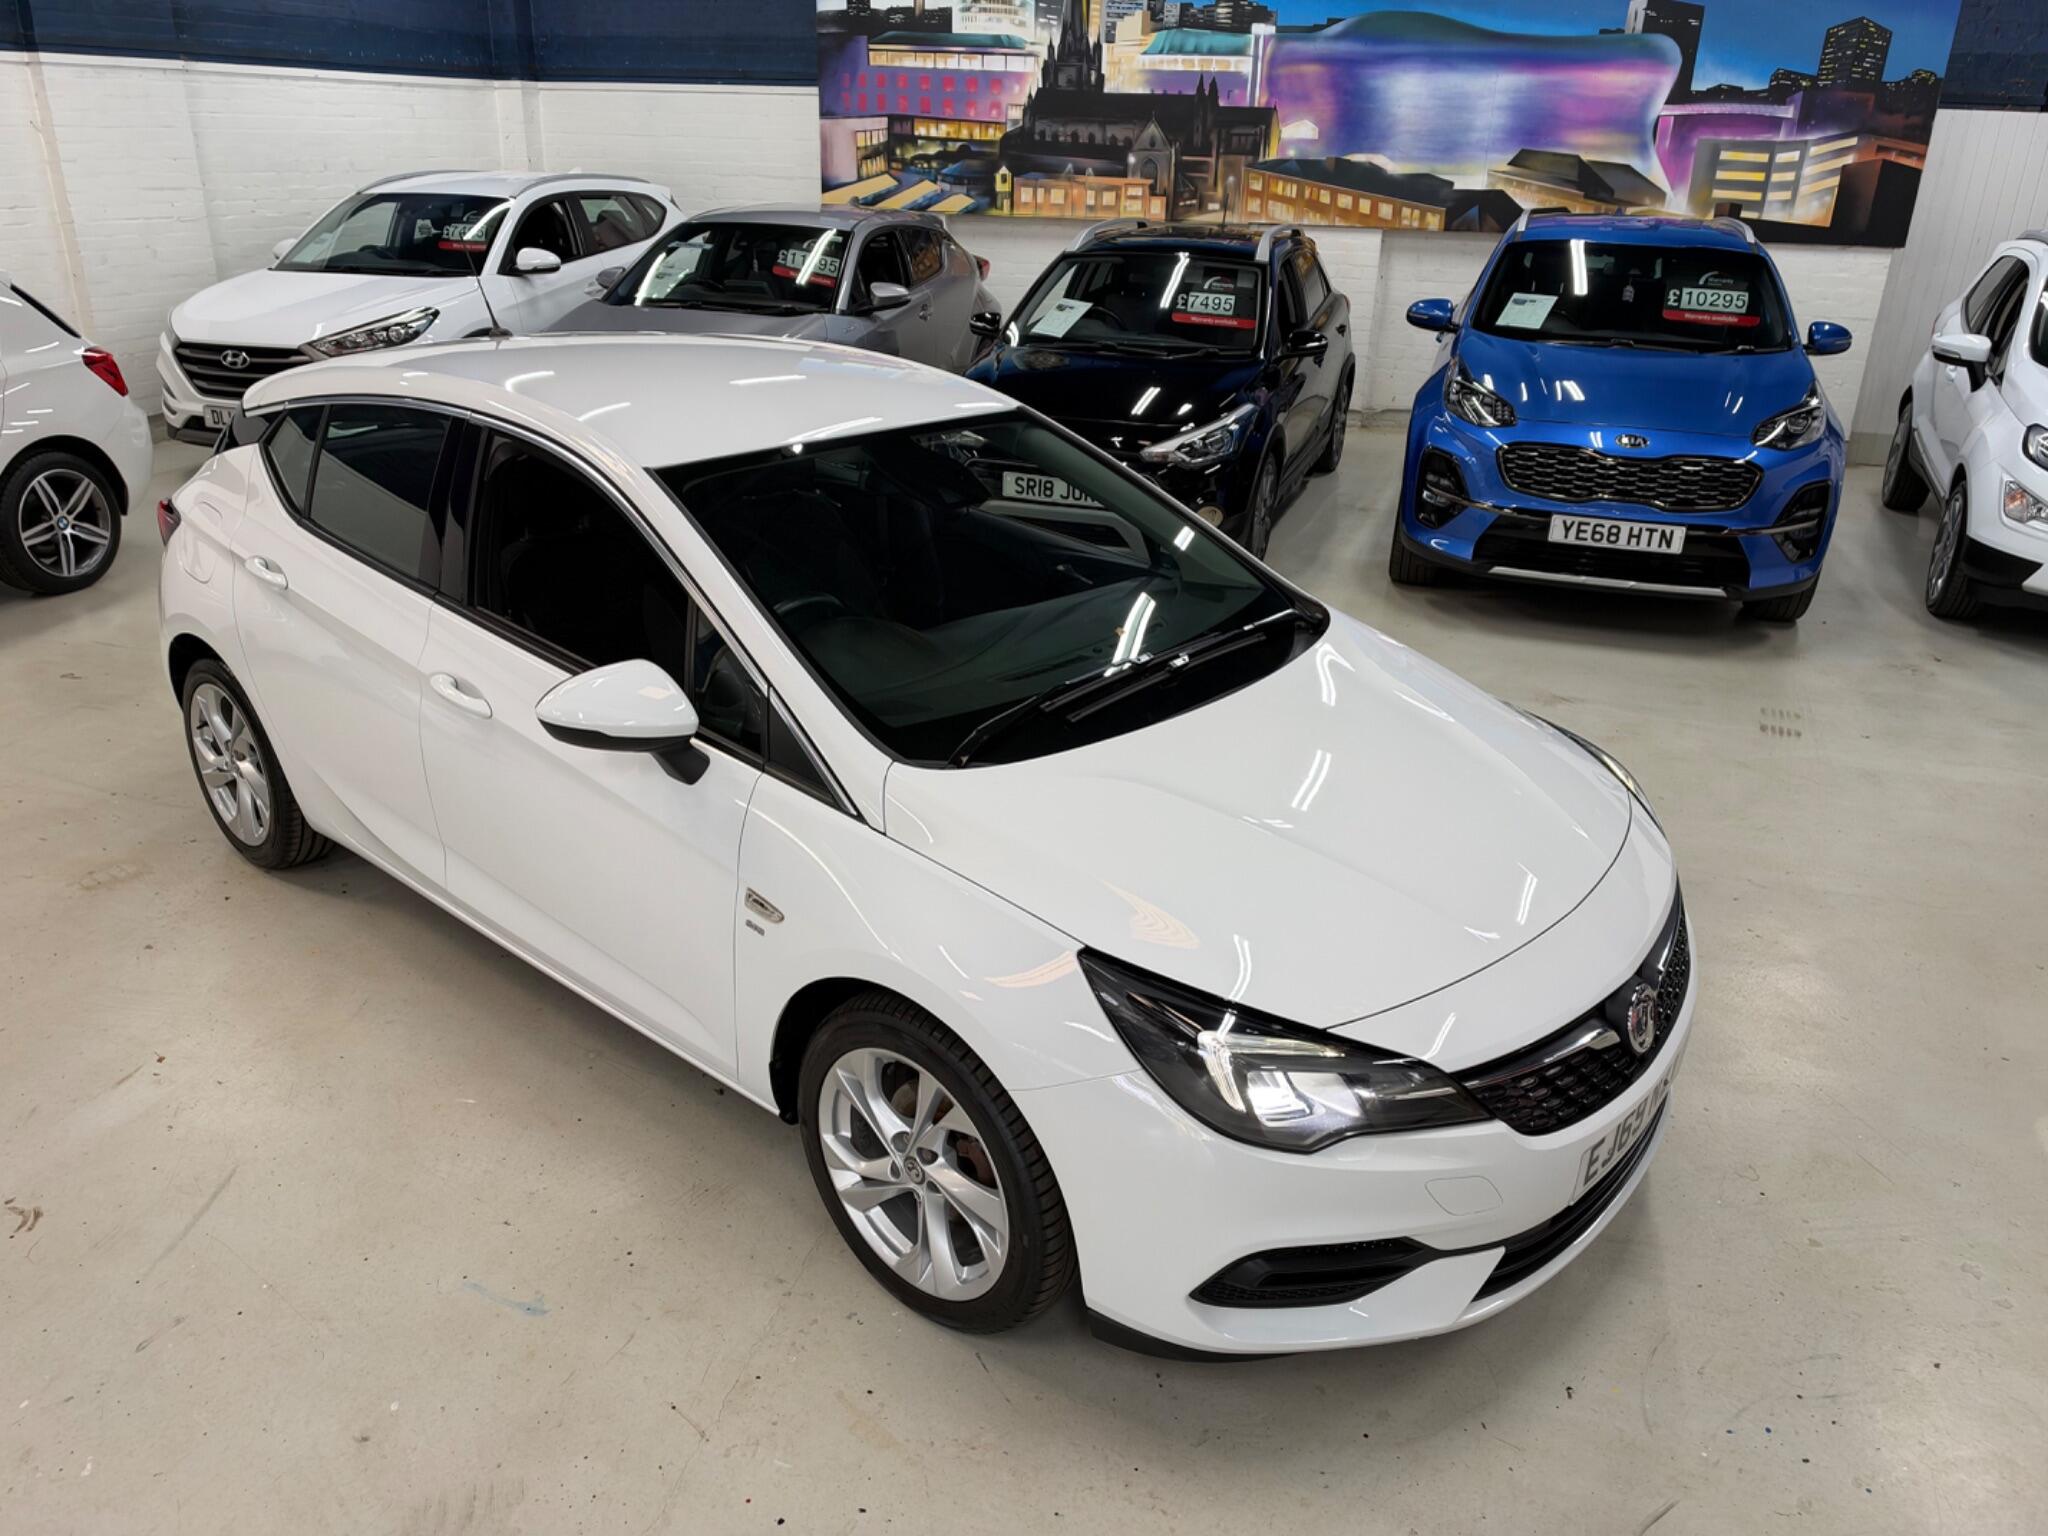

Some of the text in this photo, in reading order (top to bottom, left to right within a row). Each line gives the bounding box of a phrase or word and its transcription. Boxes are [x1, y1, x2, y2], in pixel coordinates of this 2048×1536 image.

[776, 249, 838, 273] £1195
[1176, 293, 1233, 312] £7495
[1667, 289, 1747, 309] £10295
[1014, 476, 1055, 498] SR18
[1562, 519, 1675, 549] YE68 HTN
